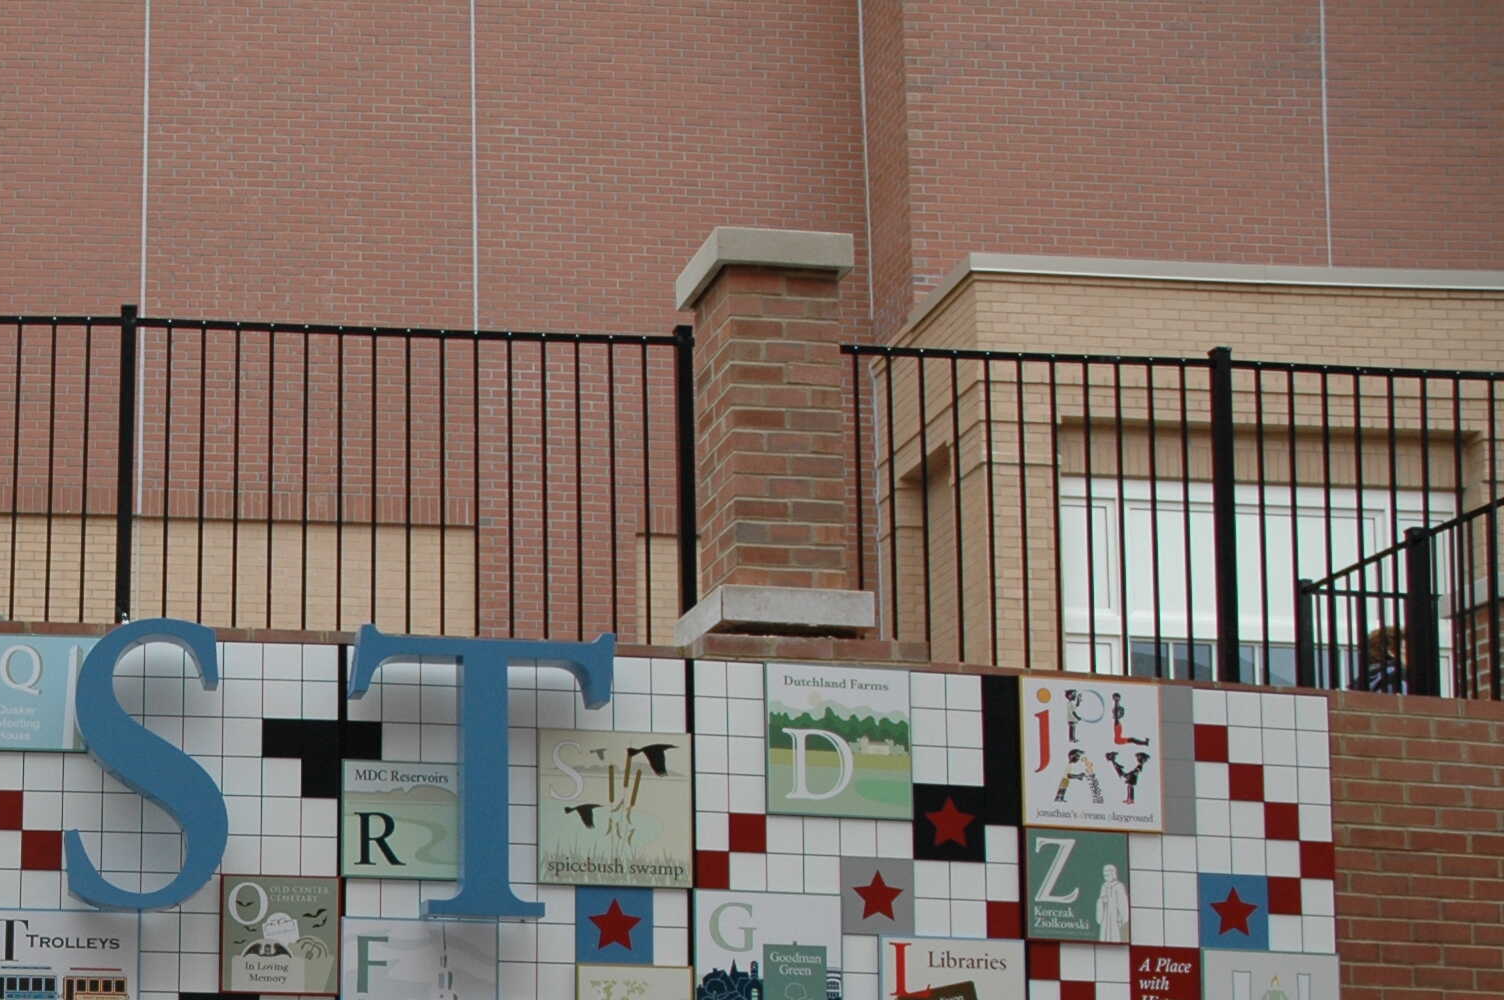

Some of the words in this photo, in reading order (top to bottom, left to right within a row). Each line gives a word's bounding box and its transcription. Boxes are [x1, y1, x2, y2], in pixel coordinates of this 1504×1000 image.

[0, 644, 43, 697] Q
[783, 675, 847, 690] Dutchland
[850, 679, 890, 692] Farms
[551, 740, 584, 801] S
[781, 727, 854, 801] D
[355, 768, 388, 781] MDC
[390, 769, 450, 784] Reservoirs
[353, 811, 408, 867] R
[547, 857, 625, 878] spicebush
[629, 861, 684, 881] swamp
[1034, 836, 1080, 904] Z
[228, 881, 269, 926] O
[708, 901, 758, 953] G
[25, 933, 121, 950] TROLLEYS
[245, 960, 256, 971] In
[257, 961, 290, 974] Loving
[356, 935, 389, 994] F
[769, 951, 823, 965] Goodman
[927, 950, 1008, 971] Libraries
[1138, 957, 1151, 973] A
[1154, 957, 1193, 974] Place
[249, 973, 288, 985] Memory
[778, 964, 813, 977] Green
[1138, 975, 1170, 991] with
